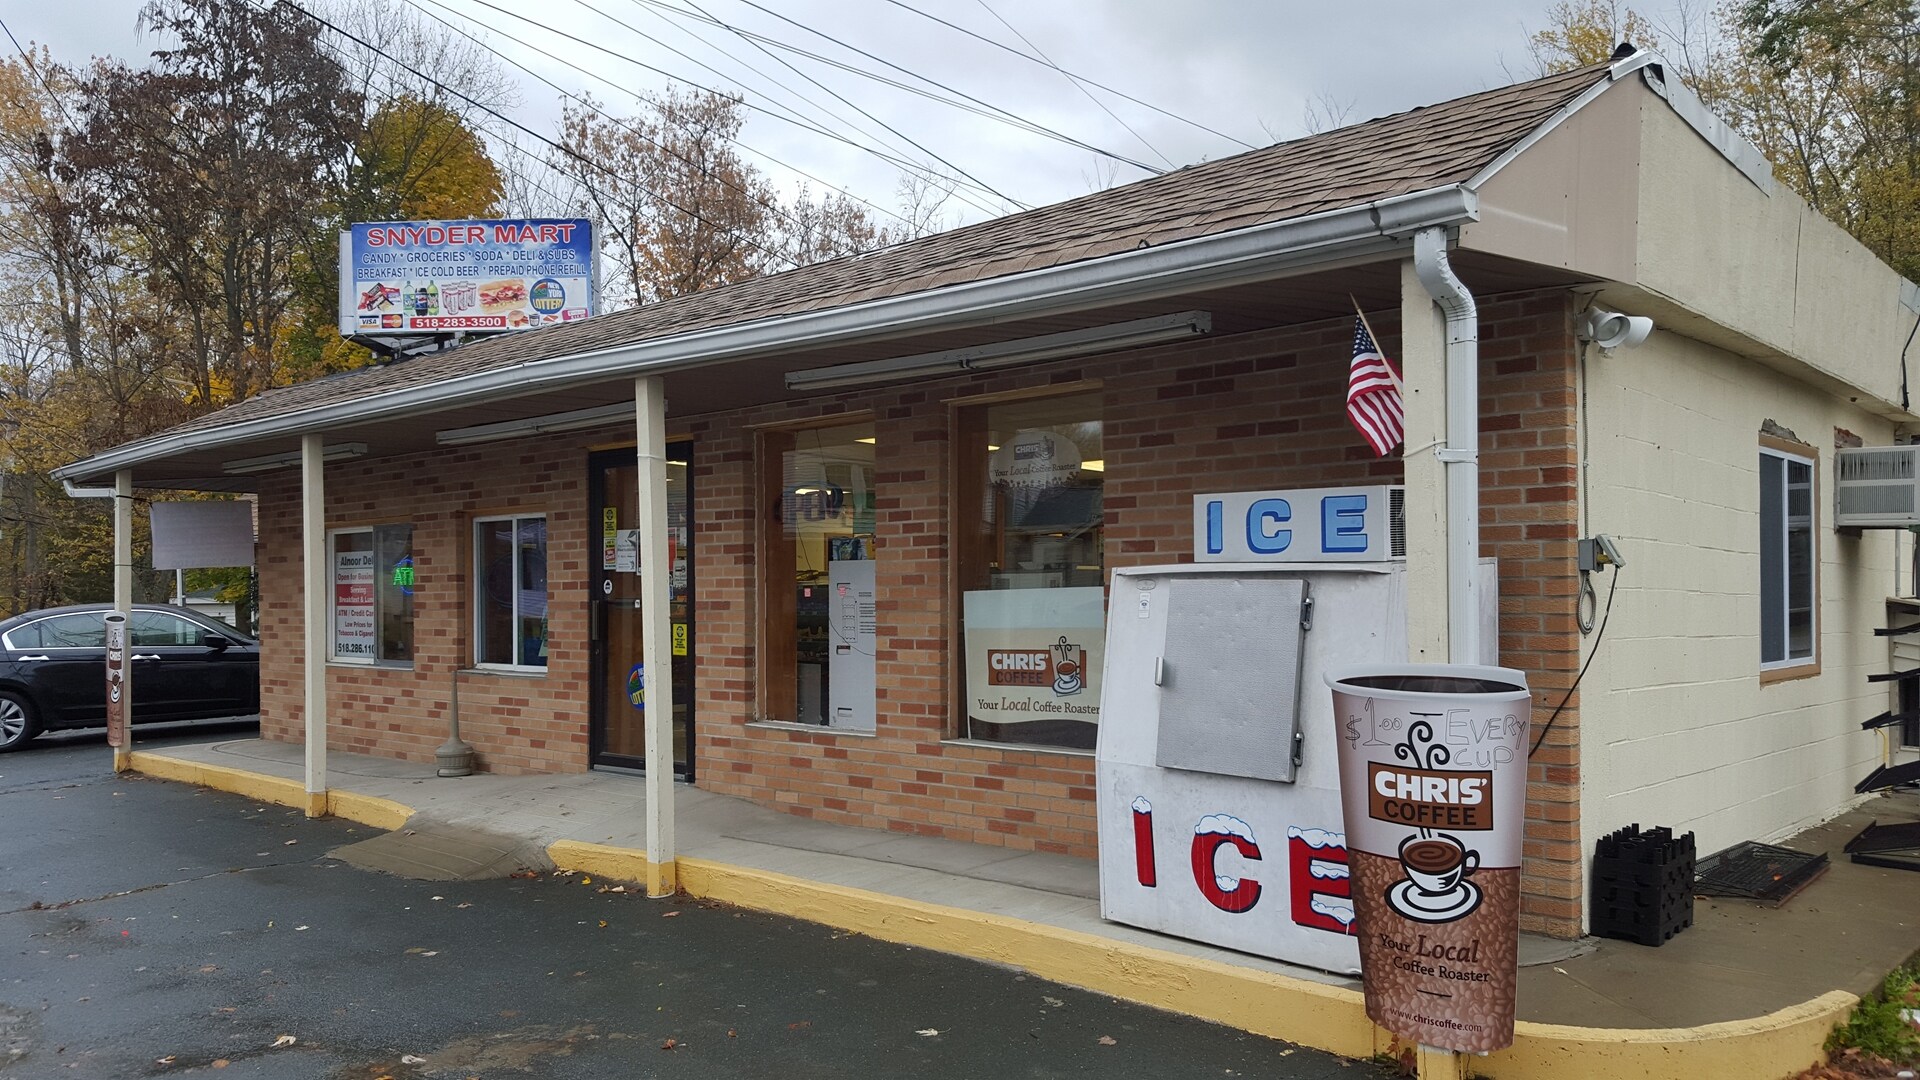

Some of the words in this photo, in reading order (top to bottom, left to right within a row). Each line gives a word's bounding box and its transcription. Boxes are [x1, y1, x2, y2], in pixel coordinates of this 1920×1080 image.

[367, 225, 486, 246] SNYDER
[494, 223, 576, 243] MART
[362, 252, 398, 264] CANDY
[406, 251, 466, 262] GROCERIES
[474, 250, 504, 261] SODA
[512, 250, 535, 260] DELI
[538, 250, 545, 260] &
[547, 249, 575, 260] SUBS
[357, 267, 407, 279] BREAKFAST
[415, 267, 429, 277] ICE
[431, 266, 454, 277] COLD
[456, 265, 479, 276] BEER
[488, 265, 525, 276] PREPAID
[526, 264, 555, 275] PHONE
[557, 263, 587, 275] REFILL
[549, 289, 563, 298] YORK
[533, 298, 564, 310] LOTTERY
[415, 317, 501, 328] 518-283-3500
[994, 469, 1008, 477] Your
[1010, 464, 1031, 476] Local
[1052, 463, 1076, 472] Roaster
[1206, 494, 1368, 555] ICE
[340, 556, 361, 567] Alnoor
[338, 573, 349, 582] Open
[351, 609, 365, 617] Credit
[991, 652, 1049, 671] CHRIS'
[996, 671, 1044, 684] COFFEE
[978, 698, 999, 710] Your
[1001, 697, 1031, 712] Local
[1033, 701, 1062, 713] Coffee
[1064, 702, 1100, 715] Roaster
[1445, 708, 1527, 750] EVERY
[1453, 746, 1515, 770] CUP
[1374, 770, 1488, 805] CHRIS'
[1383, 799, 1477, 826] COFFEE
[1131, 796, 1358, 937] ICE
[1379, 932, 1411, 953] Your
[1416, 934, 1480, 964] Local
[1393, 956, 1435, 978] Coffee
[1438, 965, 1490, 983] Roaster
[1389, 1006, 1482, 1033] www.chriscoffee.com
